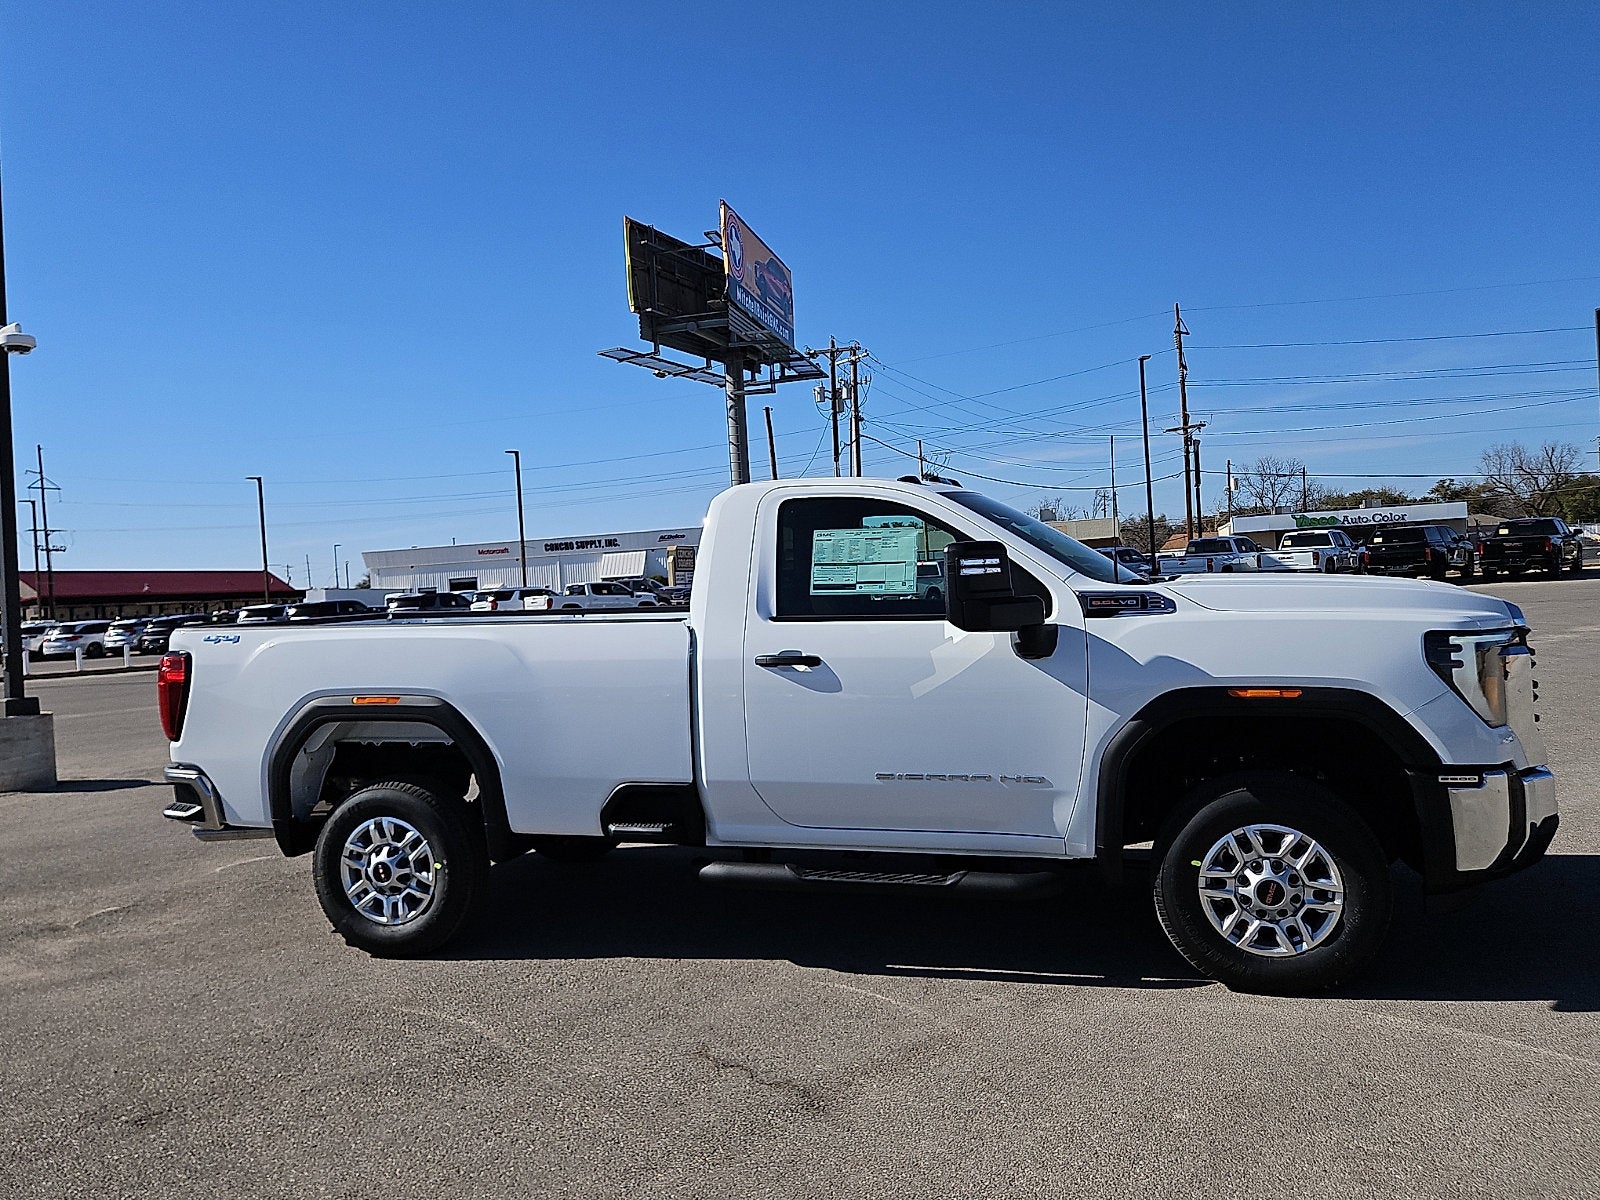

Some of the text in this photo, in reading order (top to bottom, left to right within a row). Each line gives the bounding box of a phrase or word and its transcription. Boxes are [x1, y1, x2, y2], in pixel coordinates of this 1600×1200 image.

[1341, 515, 1369, 525] Auto
[1371, 512, 1408, 523] Color
[477, 546, 510, 556] Motorcraft
[544, 541, 574, 552] CONCHO
[605, 538, 621, 548] INC.
[875, 772, 1046, 784] SIERRA HD
[1265, 882, 1277, 905] GMC
